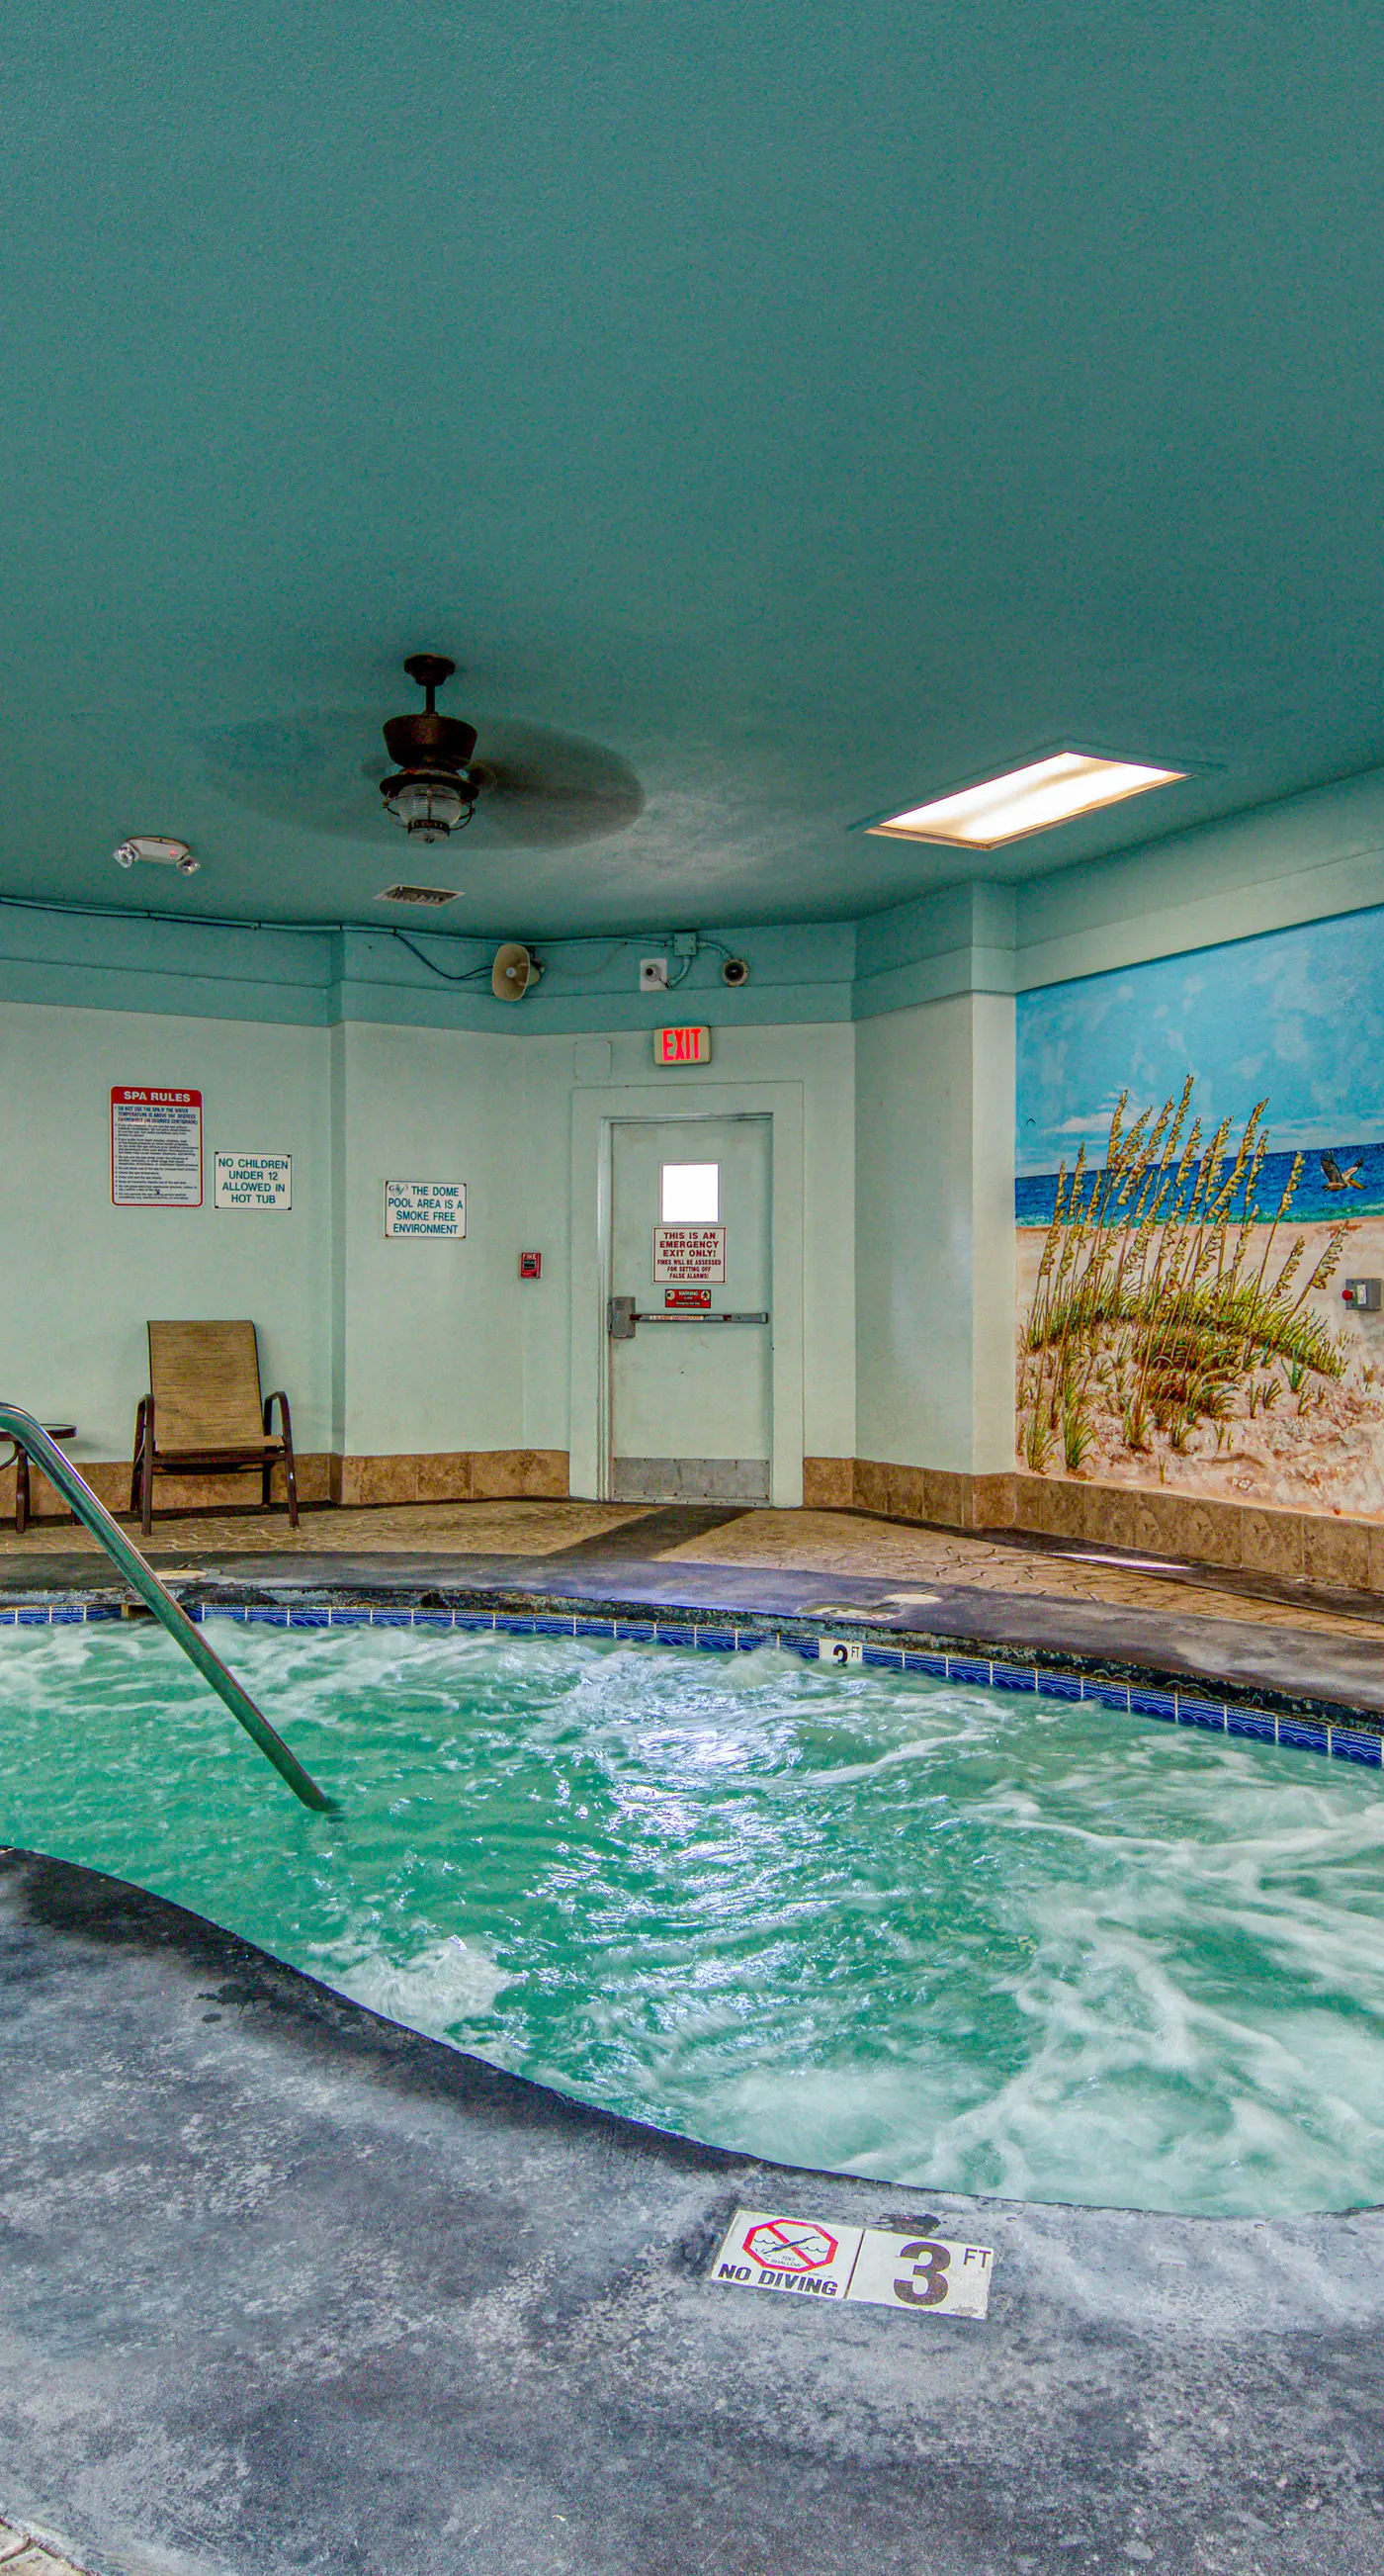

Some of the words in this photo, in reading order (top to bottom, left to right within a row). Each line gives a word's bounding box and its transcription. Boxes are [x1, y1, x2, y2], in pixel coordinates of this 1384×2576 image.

[662, 1028, 701, 1062] EXIT
[124, 1091, 147, 1101] SPA
[150, 1092, 191, 1103] RULES
[218, 1158, 233, 1168] NO
[238, 1159, 289, 1169] CHILDREN
[228, 1170, 264, 1180] UNDER
[268, 1172, 278, 1181] 12
[222, 1182, 272, 1192] ALLOWED
[275, 1184, 285, 1193] IN
[411, 1186, 429, 1196] THE
[433, 1187, 459, 1197] DOME
[231, 1194, 252, 1202] HOT
[256, 1195, 276, 1203] TUB
[388, 1198, 413, 1207] POOL
[417, 1199, 441, 1208] AREA
[445, 1199, 453, 1209] IS
[457, 1200, 463, 1209] A
[396, 1210, 429, 1220] SMOKE
[433, 1211, 456, 1221] FREE
[392, 1223, 459, 1234] ENVIRONMENT
[852, 1646, 859, 1657] FT
[771, 2259, 802, 2267] SHALLOW
[894, 2241, 951, 2307] 3
[963, 2247, 992, 2269] FT
[718, 2264, 751, 2281] NO
[757, 2269, 838, 2296] DIVING
